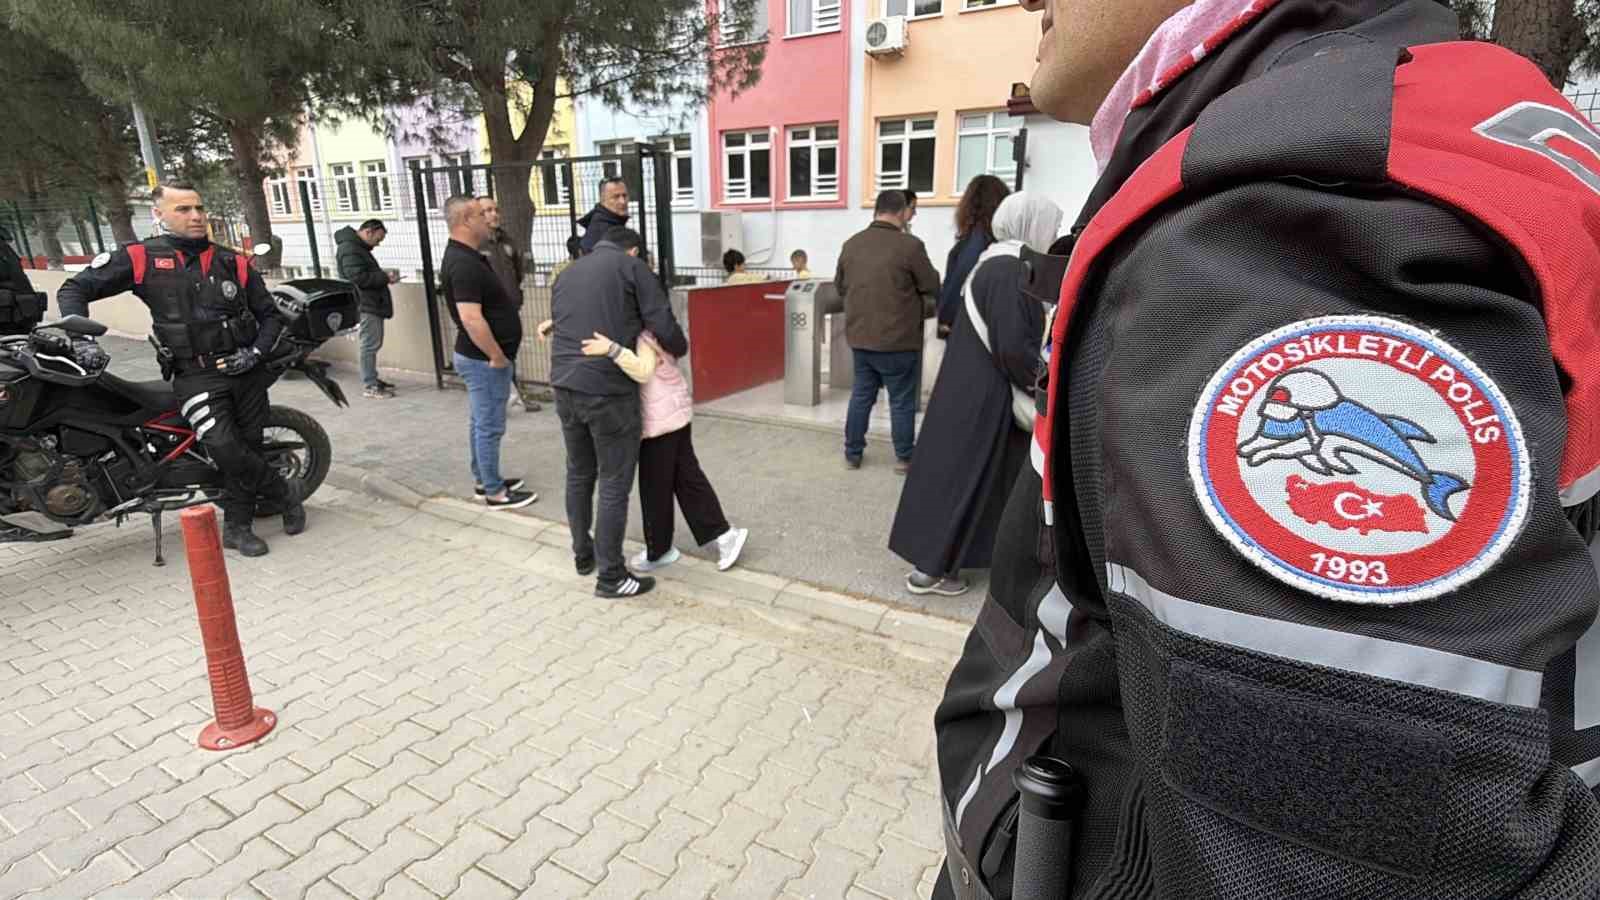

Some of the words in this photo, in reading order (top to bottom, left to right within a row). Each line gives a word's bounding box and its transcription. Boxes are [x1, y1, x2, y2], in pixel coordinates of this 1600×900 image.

[1217, 334, 1434, 417] MOTOSİKLETLİ
[1429, 366, 1501, 445] POLİS
[1310, 552, 1390, 585] 1993
